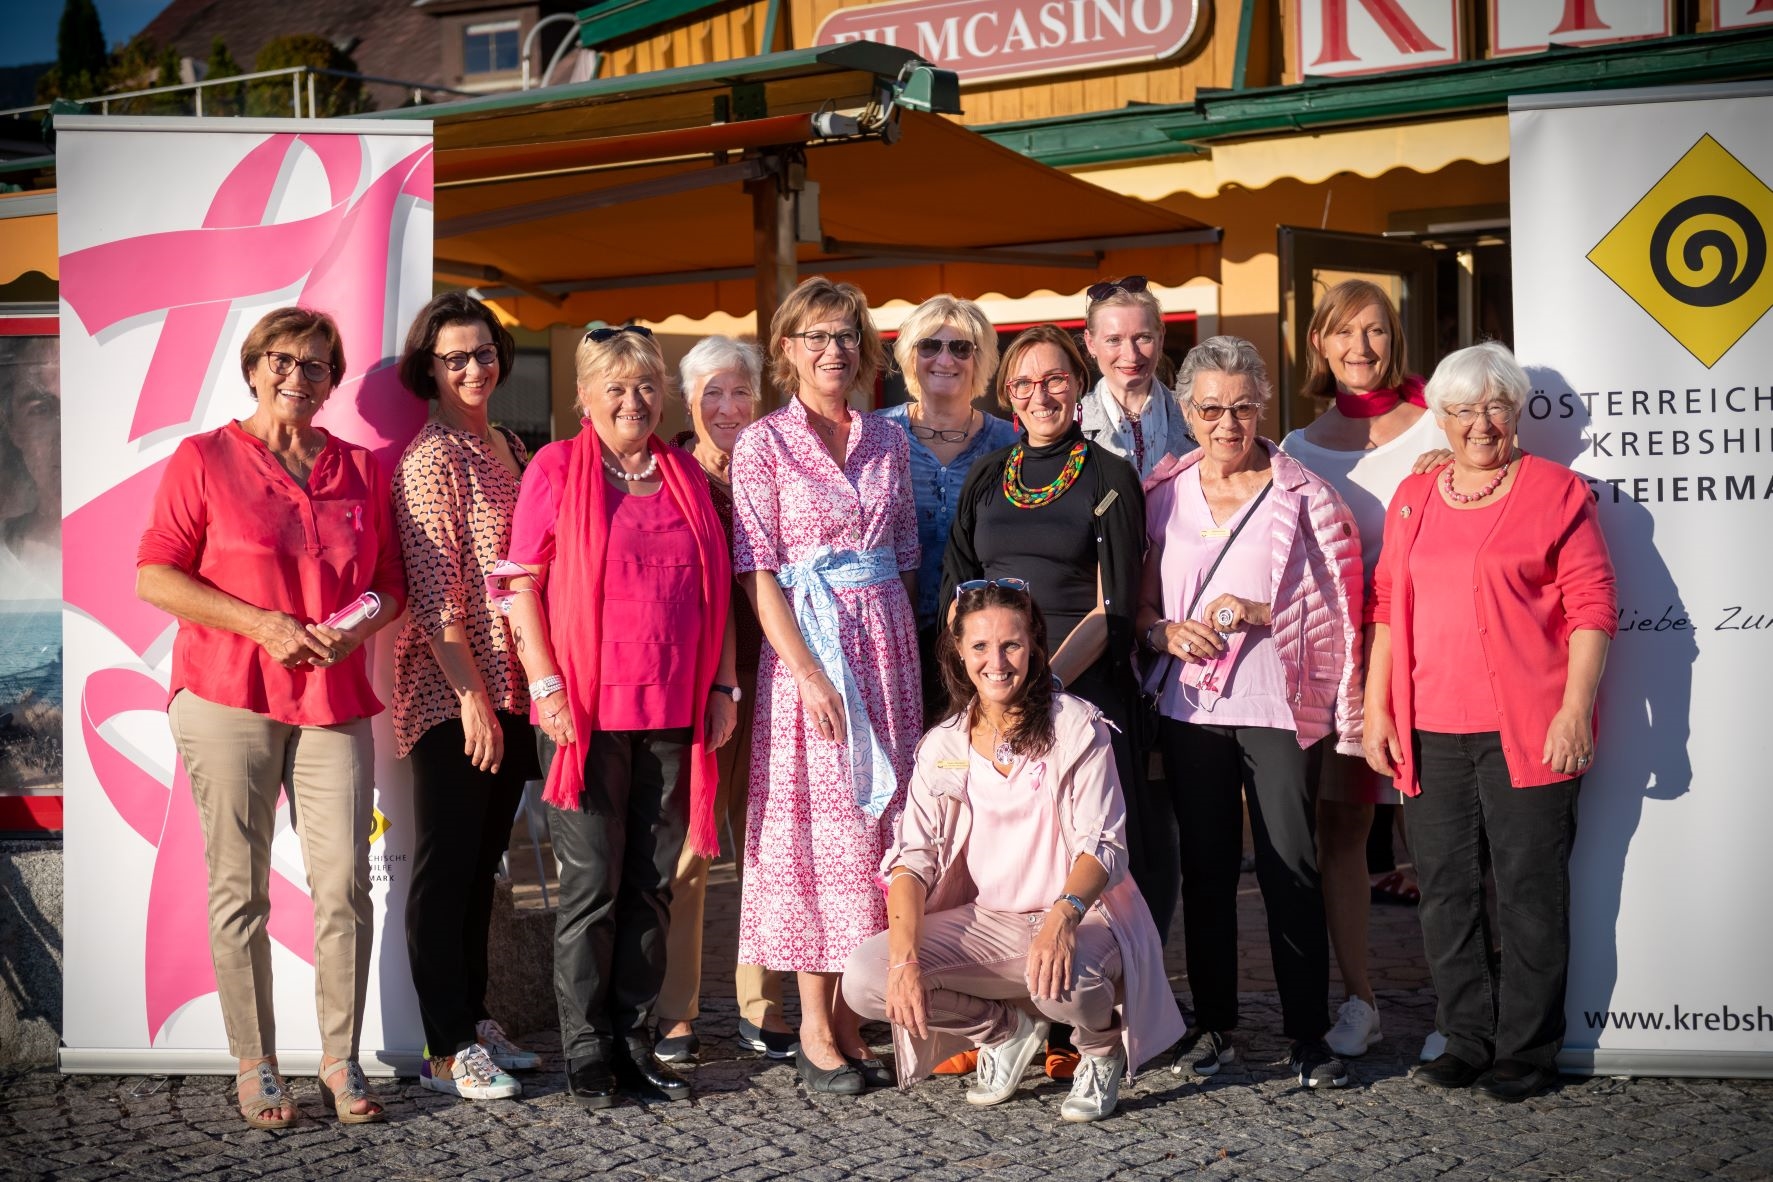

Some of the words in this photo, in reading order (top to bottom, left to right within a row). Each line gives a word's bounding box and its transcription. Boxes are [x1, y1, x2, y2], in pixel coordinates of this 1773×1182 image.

[1528, 385, 1773, 420] ÖSTERREICH
[1592, 427, 1773, 458] KREBSHI
[1584, 1004, 1773, 1032] www.krebsh
